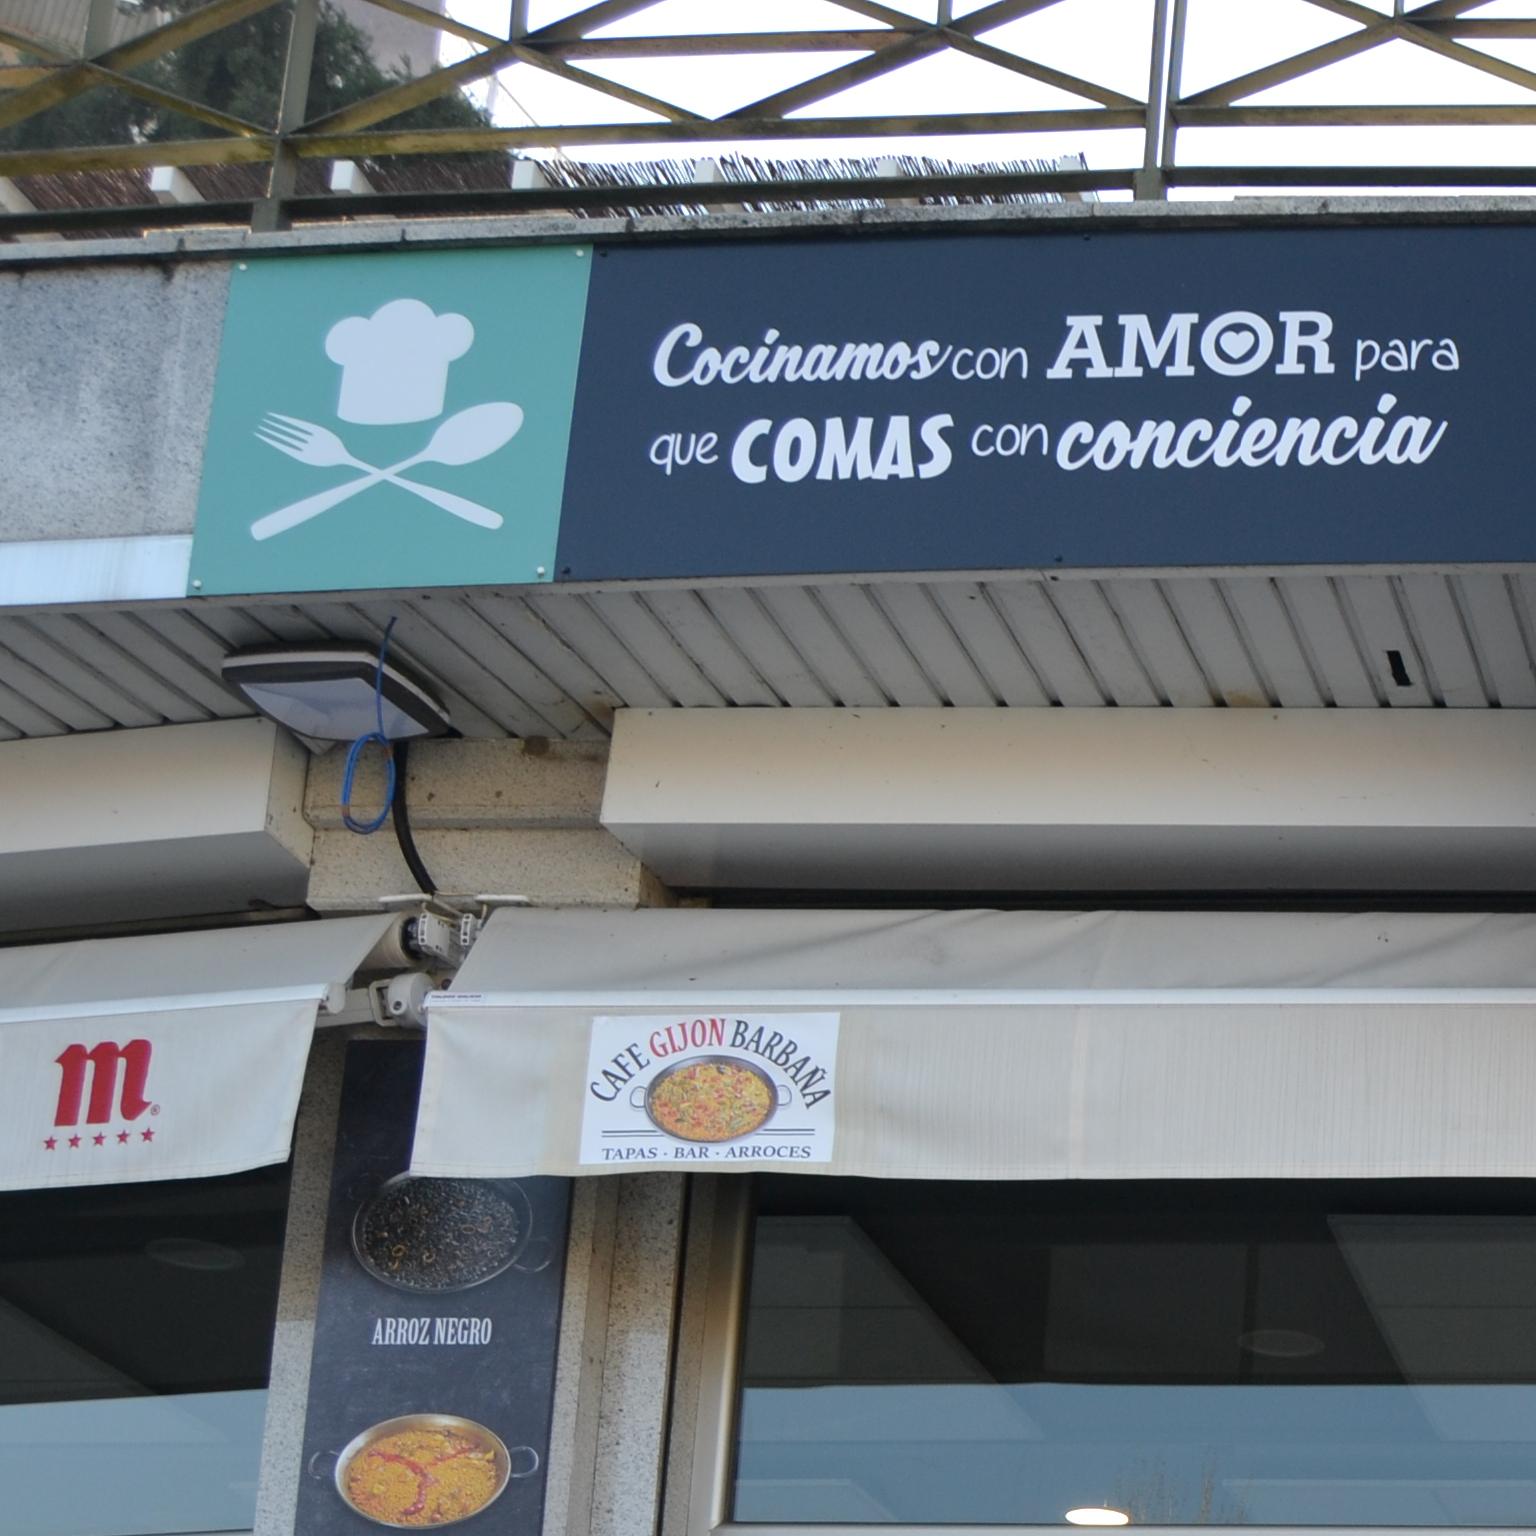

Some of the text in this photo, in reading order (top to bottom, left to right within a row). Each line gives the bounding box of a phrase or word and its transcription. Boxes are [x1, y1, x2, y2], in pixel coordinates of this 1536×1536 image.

[652, 309, 1461, 388] Cocinamos con AMOR para
[649, 395, 1447, 485] que COMAS con conciencia
[590, 1018, 831, 1109] CAFE GIJON BARBAÑA
[602, 1145, 811, 1160] TAPAS BAR ARROCES
[371, 1317, 492, 1345] ARROZ NEGRO
